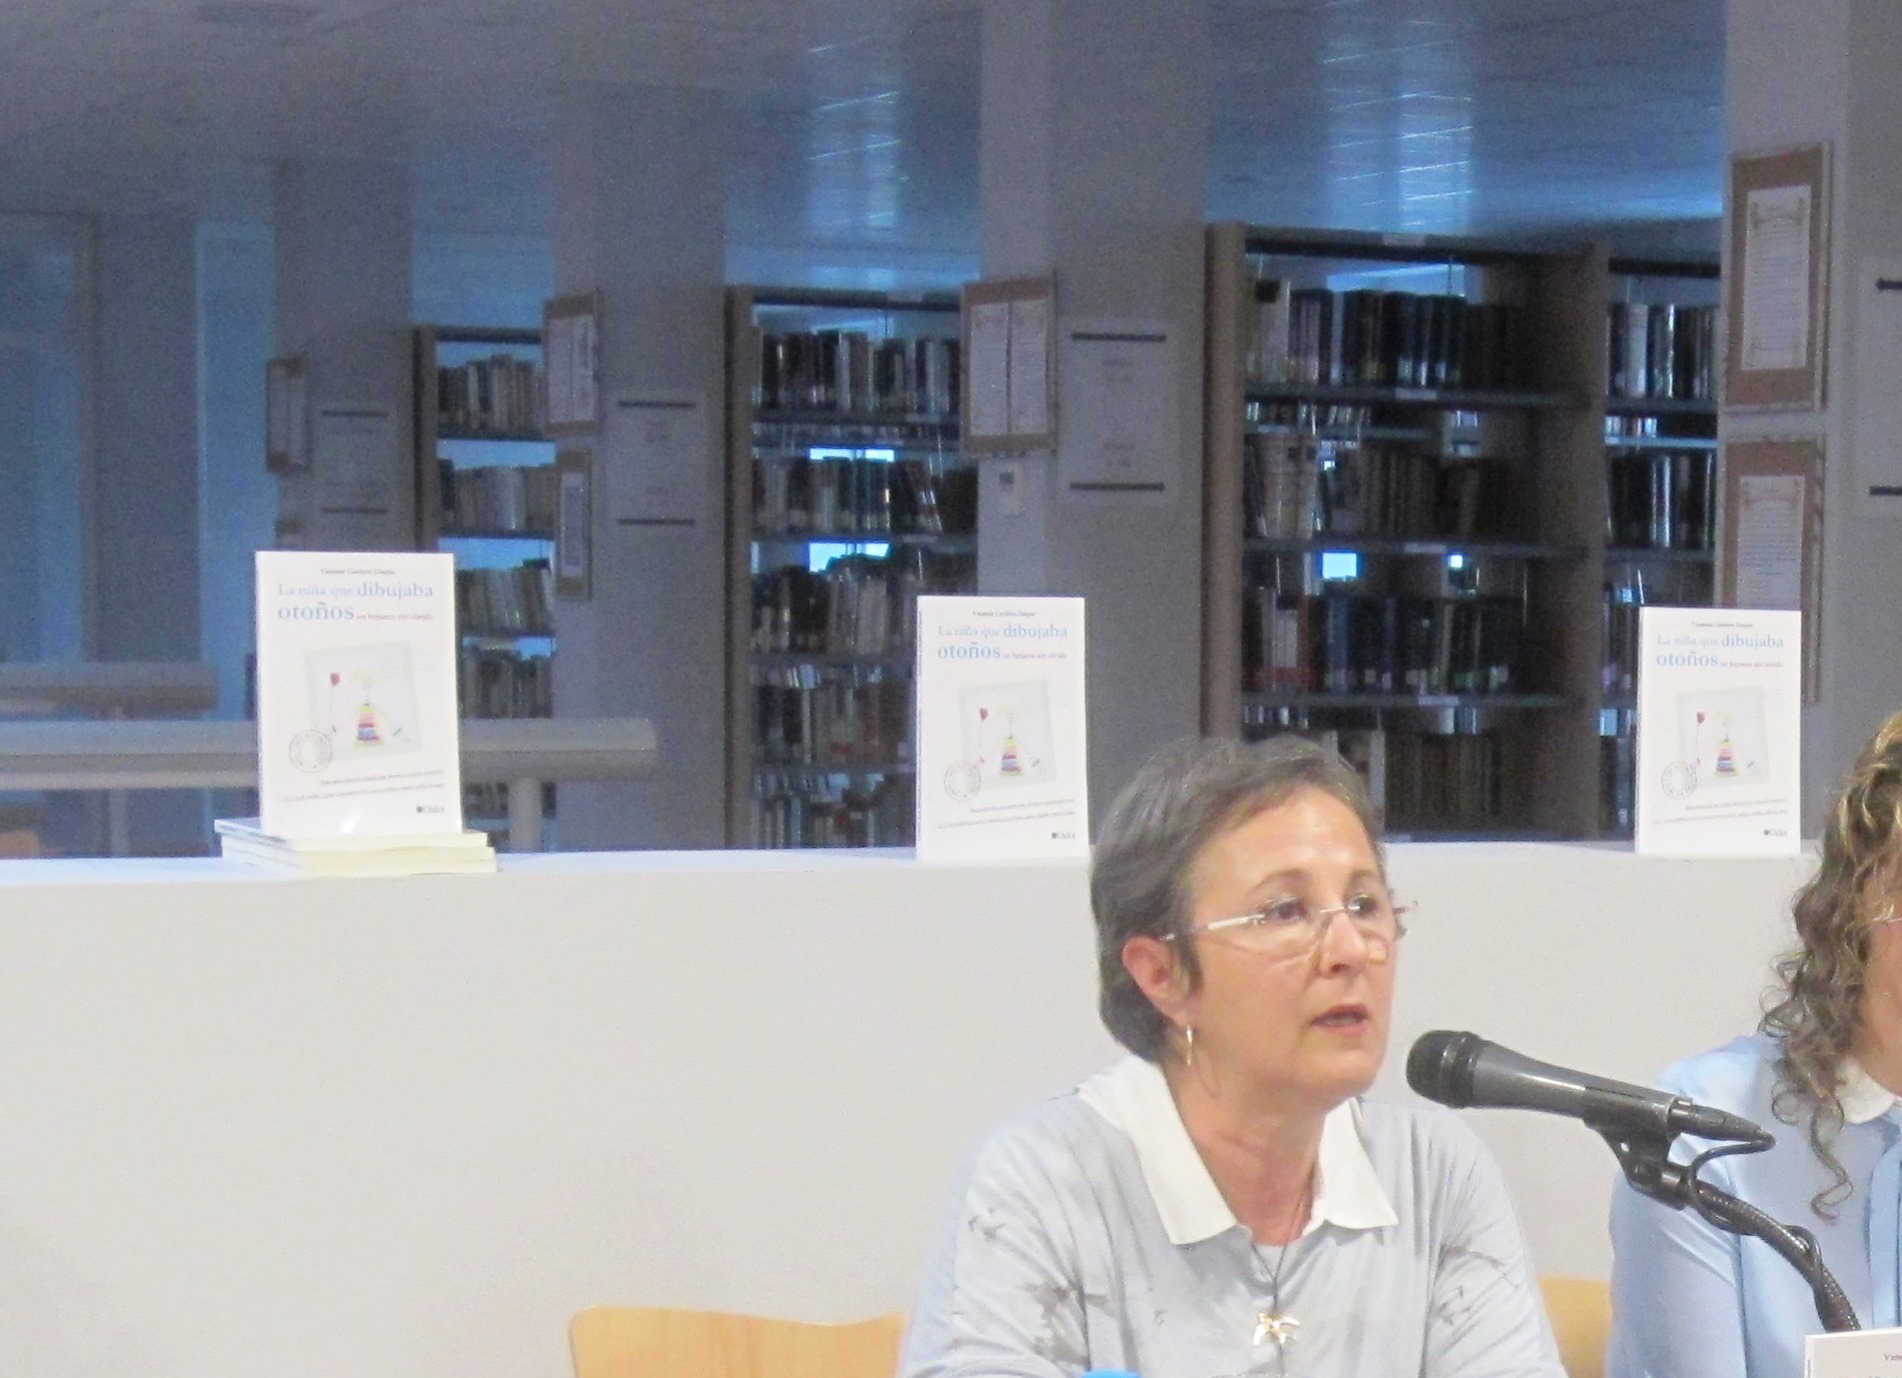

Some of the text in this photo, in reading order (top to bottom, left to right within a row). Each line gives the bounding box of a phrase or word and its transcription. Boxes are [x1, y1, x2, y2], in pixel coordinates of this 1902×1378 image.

[356, 582, 433, 600] dibujaba
[278, 602, 354, 620] otoños
[1003, 623, 1068, 639] dibujaba
[1721, 634, 1784, 650] dibujaba
[938, 642, 1001, 659] otoños
[1656, 651, 1719, 667] otoños
